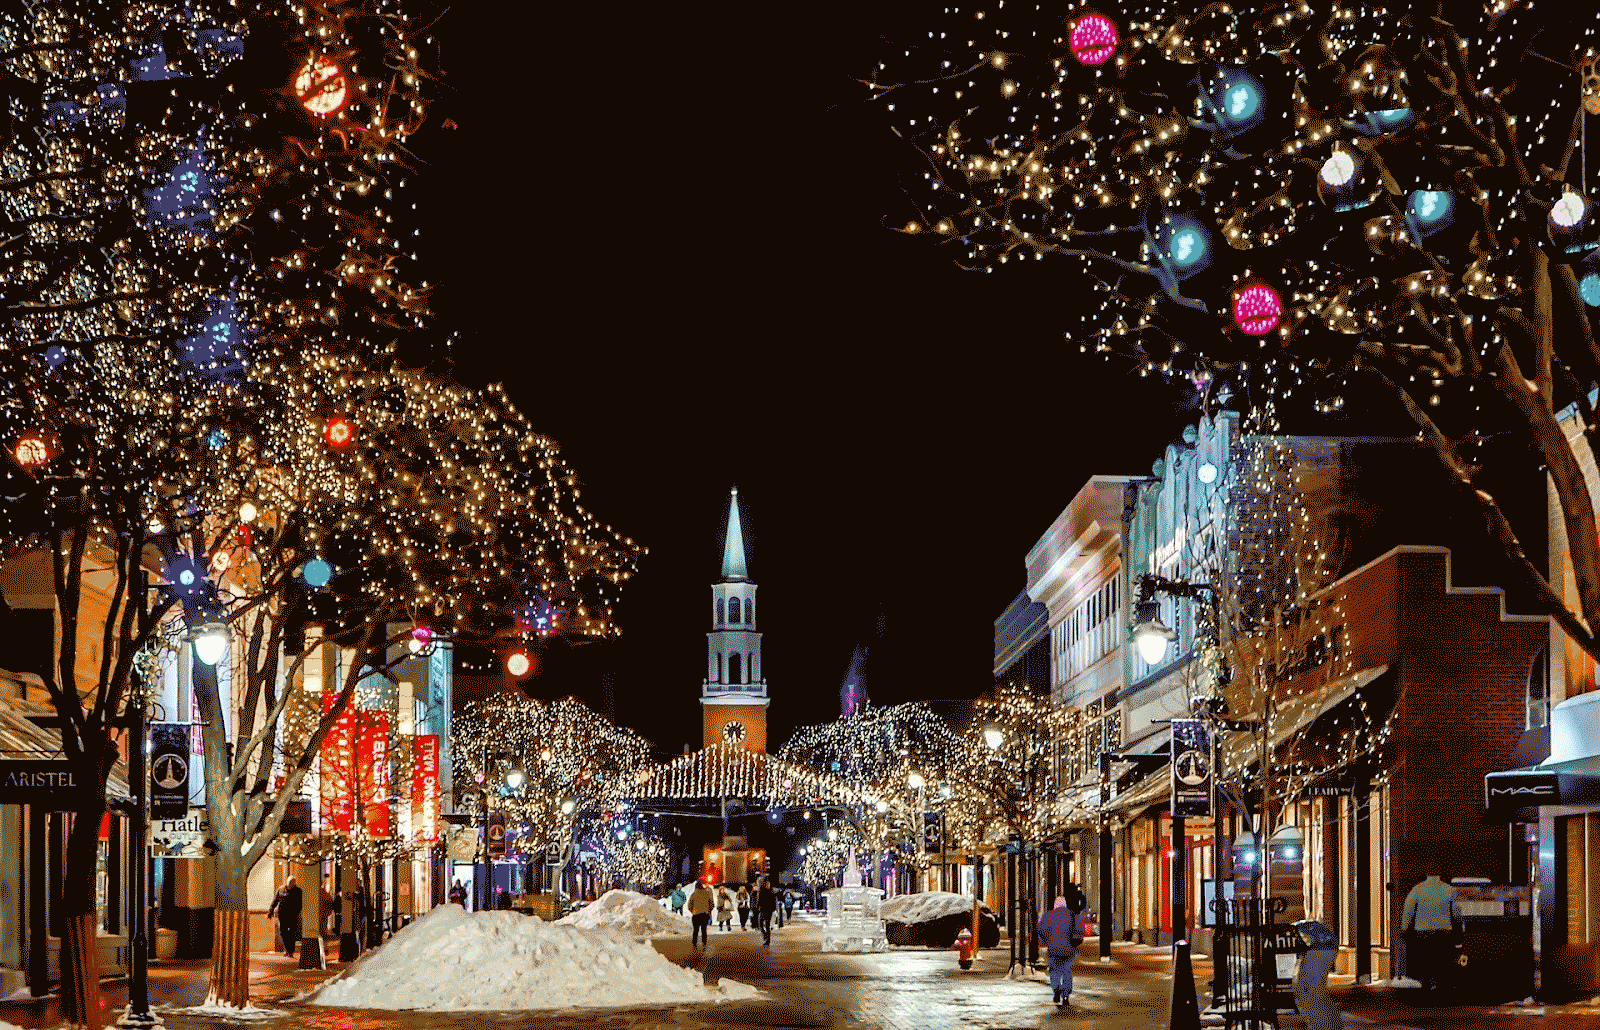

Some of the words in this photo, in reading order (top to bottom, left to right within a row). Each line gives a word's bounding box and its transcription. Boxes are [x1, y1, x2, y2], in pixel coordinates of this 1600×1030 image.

[422, 738, 435, 772] MALL
[5, 772, 77, 787] ARISTEL
[1490, 786, 1554, 796] MAC
